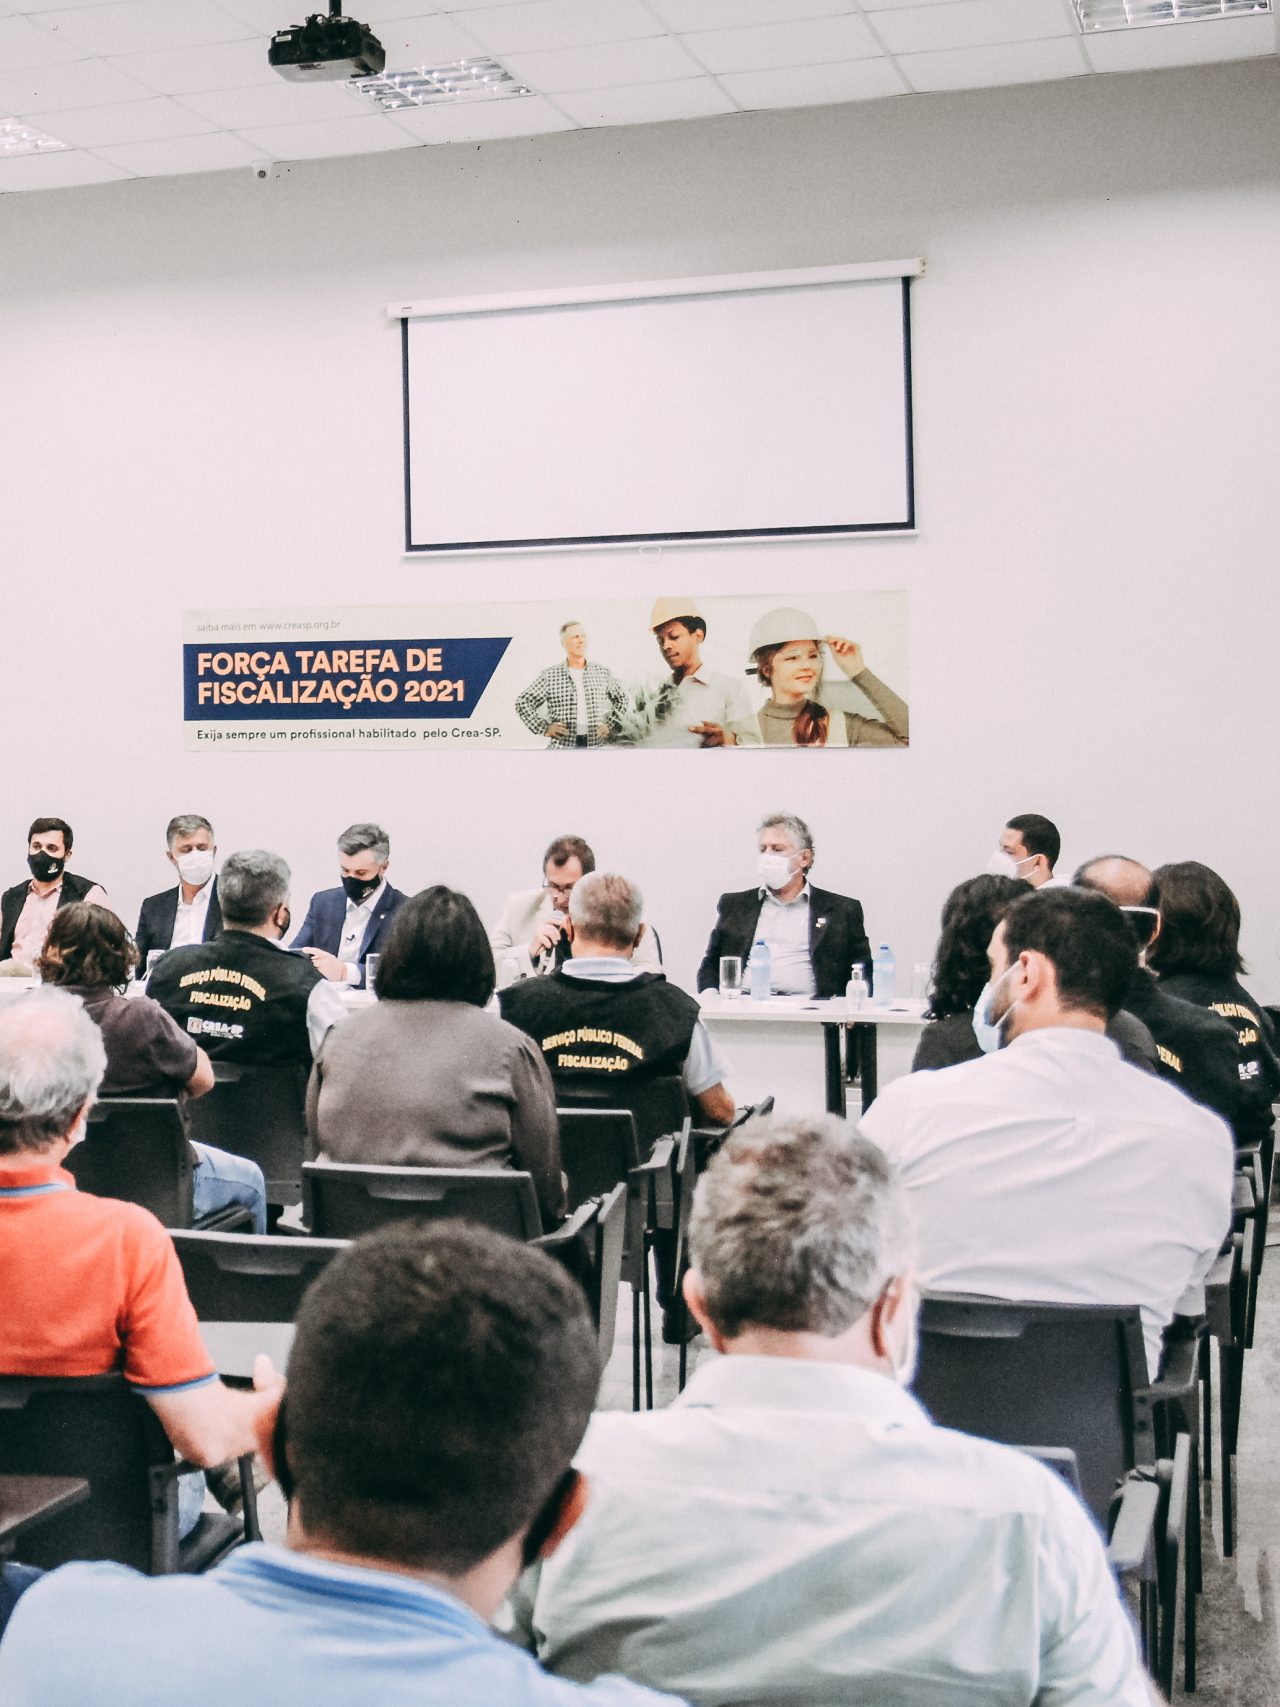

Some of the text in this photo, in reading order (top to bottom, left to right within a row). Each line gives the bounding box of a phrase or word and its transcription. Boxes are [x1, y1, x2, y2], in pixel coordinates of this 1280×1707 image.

[197, 620, 341, 632] saiba mais em www.creasp.org.br
[197, 648, 443, 681] FORÇA TAREFA DE
[198, 674, 465, 709] FISCALIZAÇÃO 2021
[197, 727, 502, 742] Exija sempre um profissional habilitado pelo Crea-SP.
[189, 990, 252, 1012] FISCALIZAÇÃO
[542, 1026, 644, 1060] SERVIÇO PÚBLICO FEDERAL
[558, 1053, 629, 1073] FISCALIZAÇÃO
